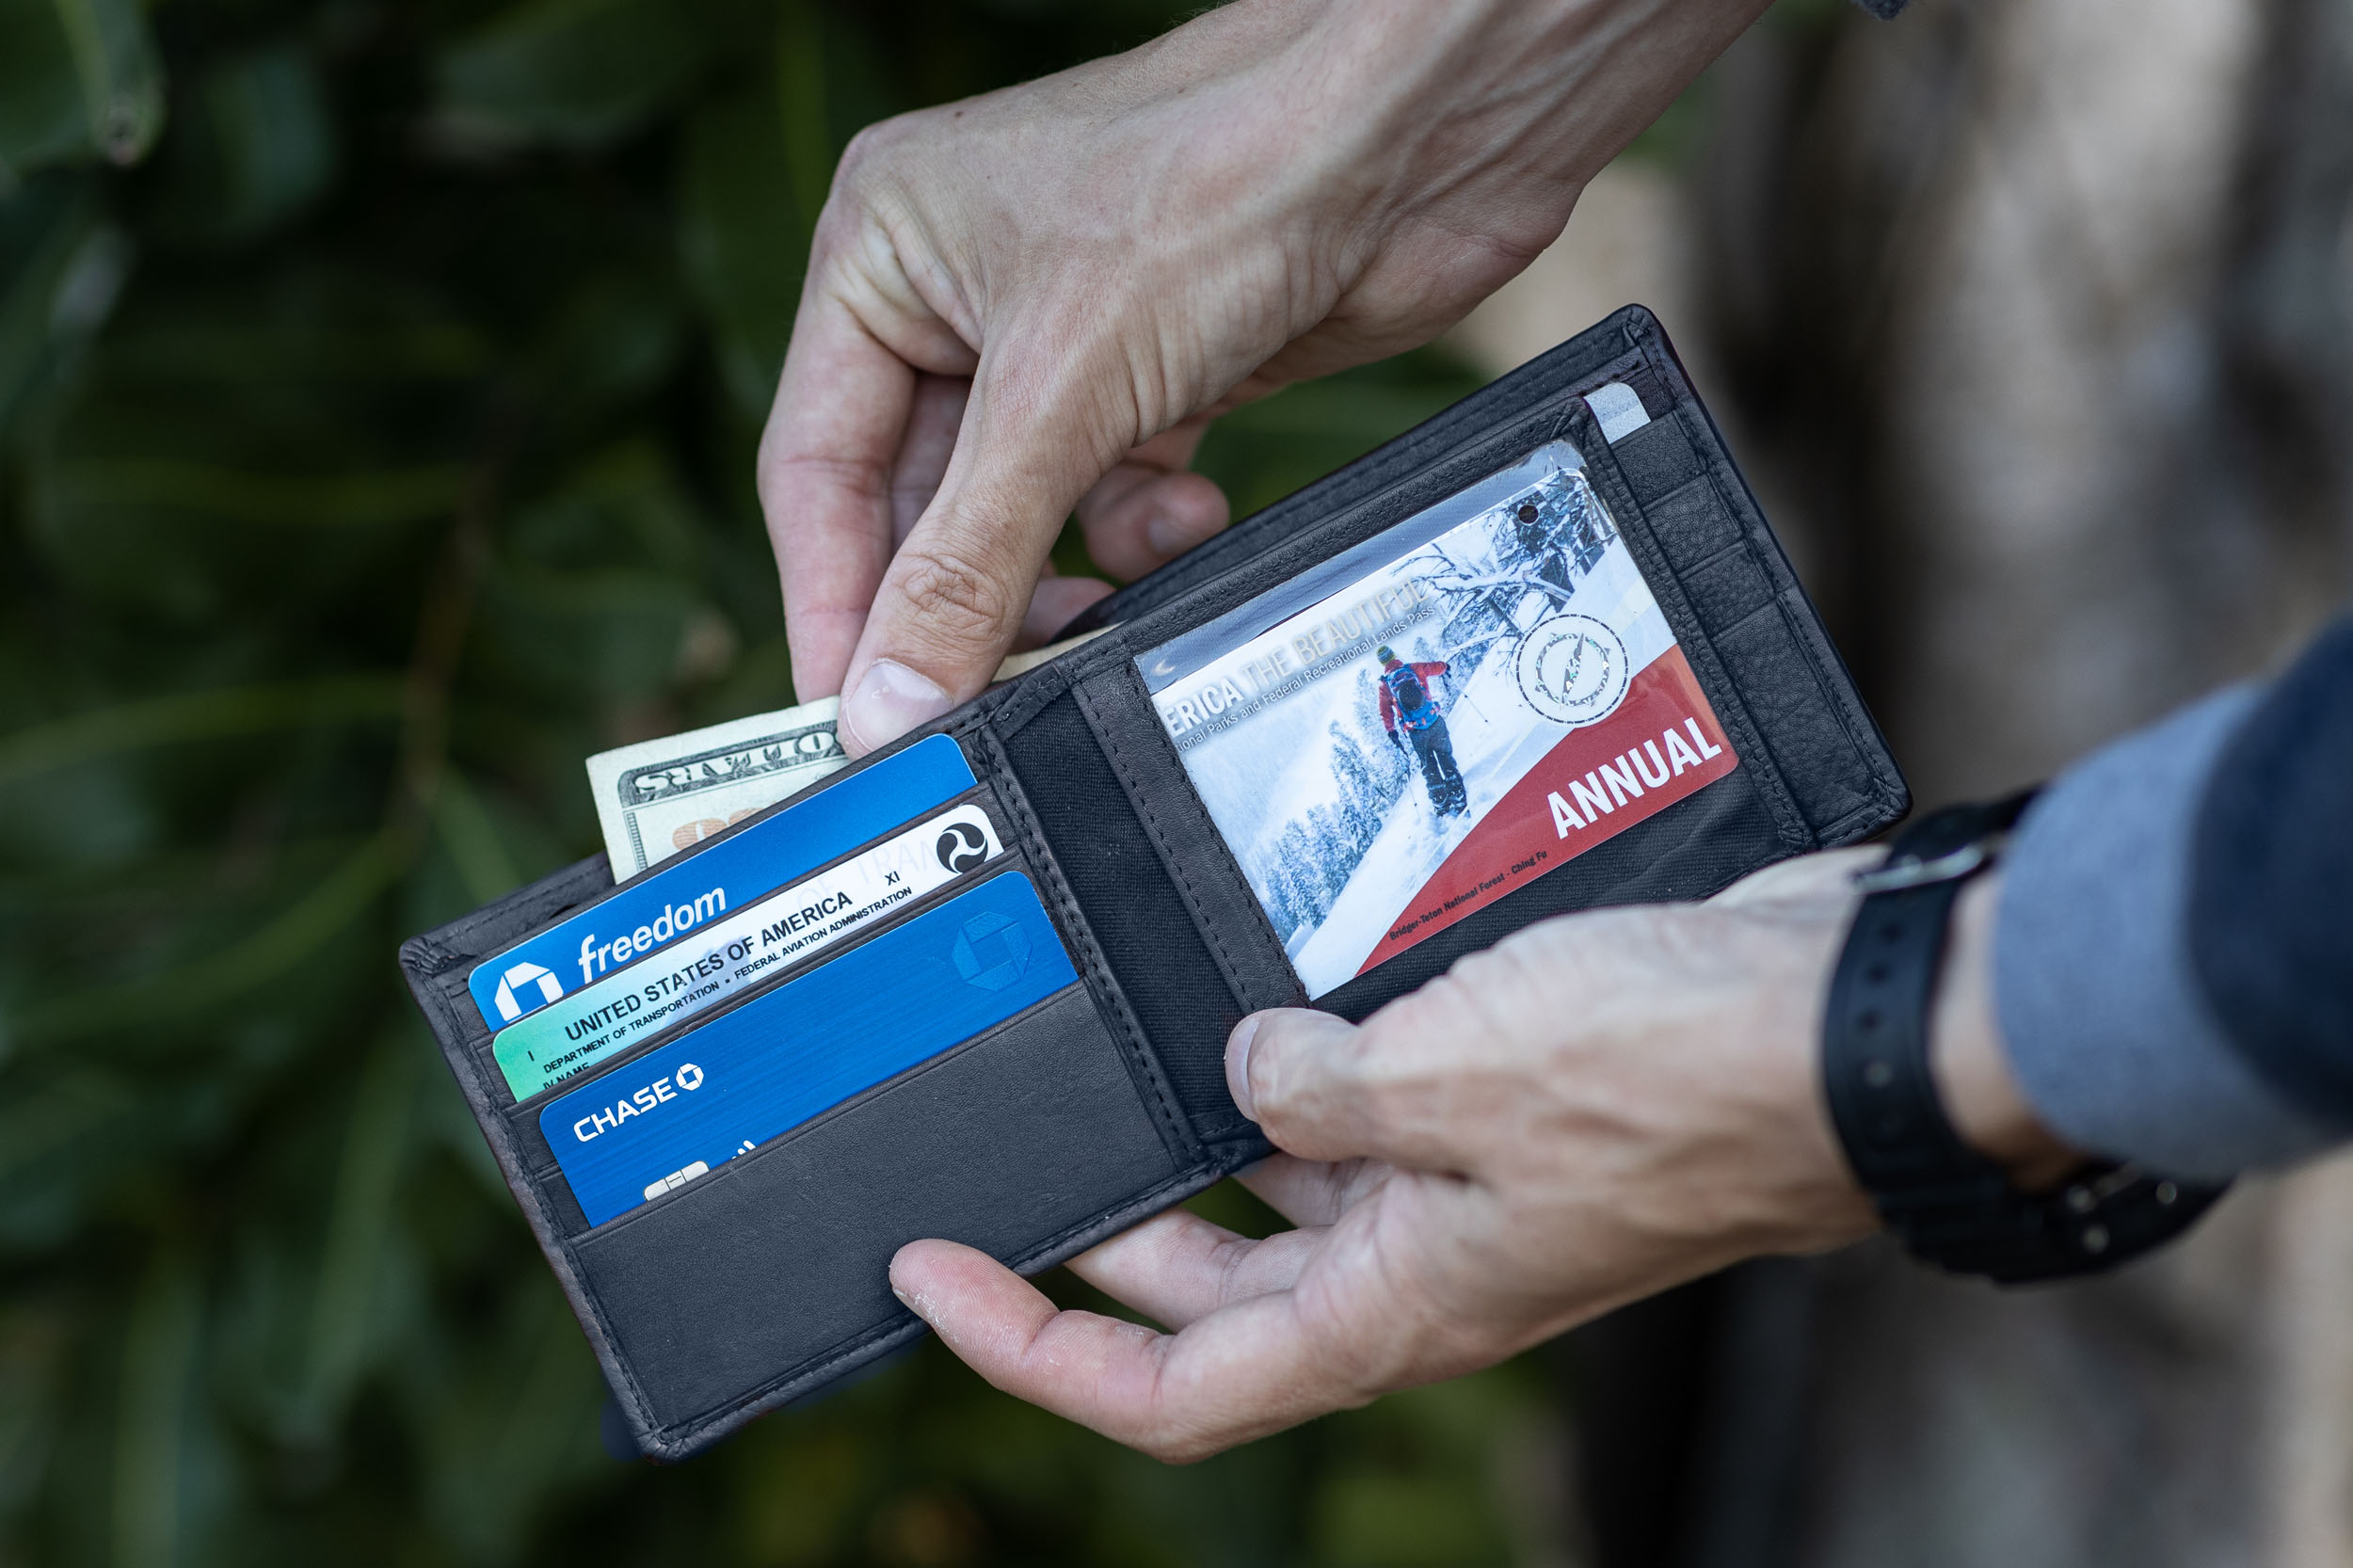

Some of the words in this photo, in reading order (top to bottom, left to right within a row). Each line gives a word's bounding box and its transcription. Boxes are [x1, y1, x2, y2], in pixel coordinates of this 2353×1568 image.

[1163, 678, 1244, 739] ERICA
[1243, 647, 1295, 692] THE
[1292, 578, 1431, 666] BEAUTIFUL
[1175, 728, 1207, 753] tional
[1207, 712, 1239, 736] Parks
[1241, 700, 1261, 718] and
[1262, 677, 1304, 706] Federal
[1305, 637, 1372, 682] Recreational
[1372, 619, 1408, 645] Lands
[1408, 605, 1435, 628] Pass
[633, 731, 836, 794] OLLARS
[1546, 716, 1723, 840] ANNUAL
[885, 871, 901, 886] XI
[1389, 907, 1444, 941] Bridger-Teton
[1444, 887, 1479, 912] National
[1479, 872, 1506, 892] Forest
[543, 1034, 611, 1074] DEPARTMENT
[613, 1026, 627, 1039] OF
[629, 981, 720, 1030] TRANSPORTATION
[734, 952, 781, 980] FEDERAL
[782, 927, 828, 957] AVIATION
[829, 886, 913, 934] ADMINISTRATION
[565, 993, 641, 1041] UNITED
[644, 952, 725, 1002] STATES
[727, 936, 755, 961] OF
[761, 890, 853, 947] AMERICA
[578, 887, 727, 984] freedom
[573, 1076, 679, 1143] CHASE
